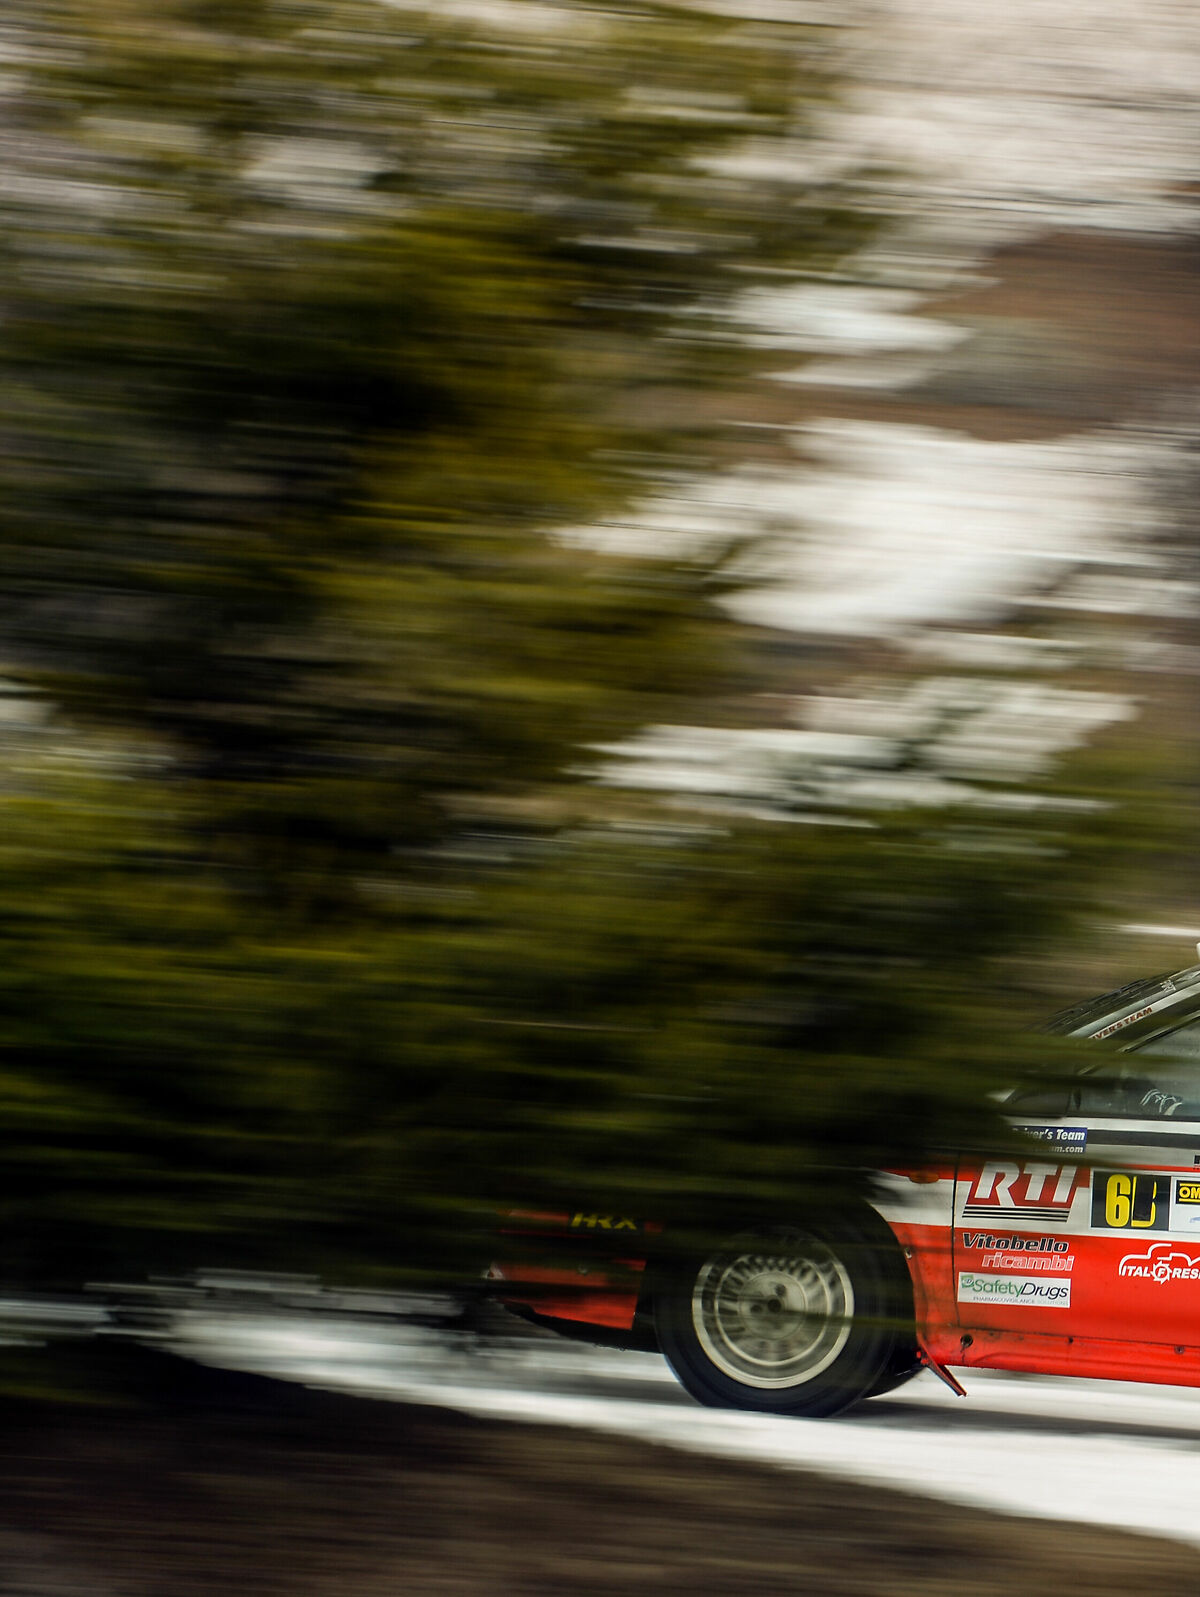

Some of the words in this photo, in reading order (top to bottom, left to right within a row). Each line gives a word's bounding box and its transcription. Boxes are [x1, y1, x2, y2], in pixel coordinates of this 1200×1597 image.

[1124, 1007, 1153, 1024] TEAM
[1056, 1129, 1085, 1141] Team
[974, 1161, 1079, 1207] RTI
[963, 1232, 1070, 1253] Vitobello
[982, 1252, 1075, 1271] ricambi
[972, 1279, 1069, 1300] SafetyDrugs
